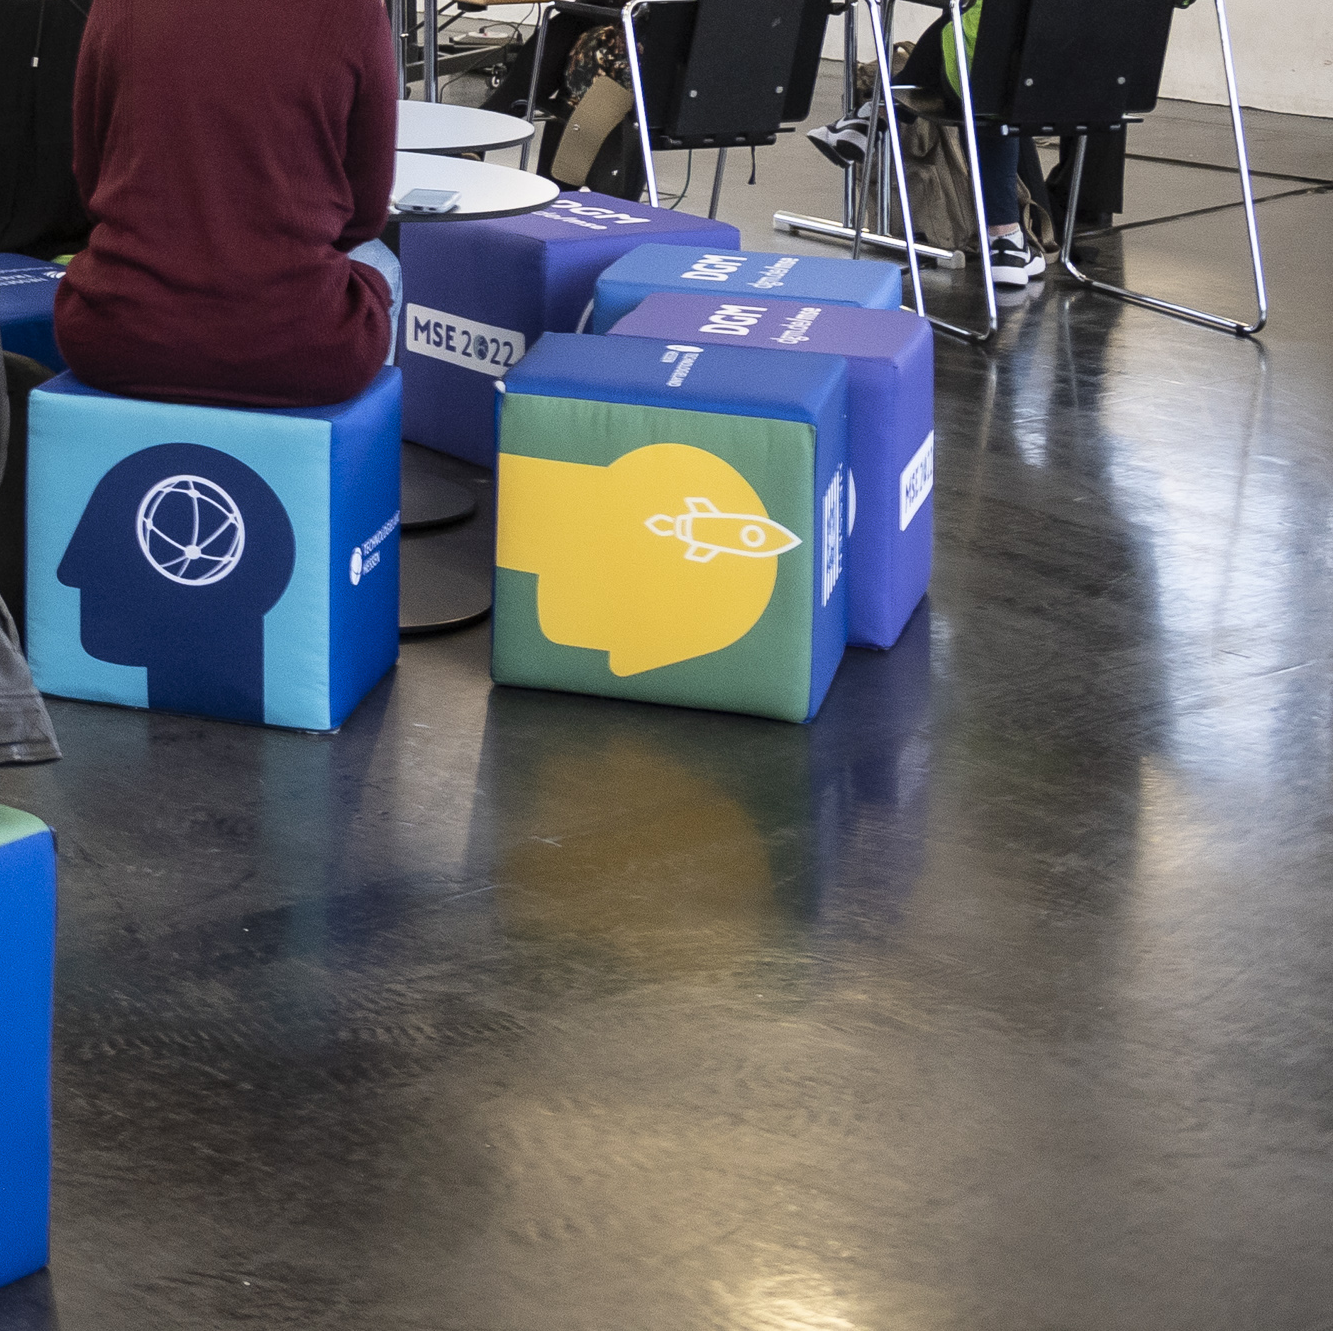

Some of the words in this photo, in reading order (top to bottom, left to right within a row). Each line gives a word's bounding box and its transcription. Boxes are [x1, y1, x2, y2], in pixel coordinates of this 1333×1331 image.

[680, 254, 748, 281] DGM
[413, 315, 458, 353] MSE
[698, 303, 768, 336] DGM
